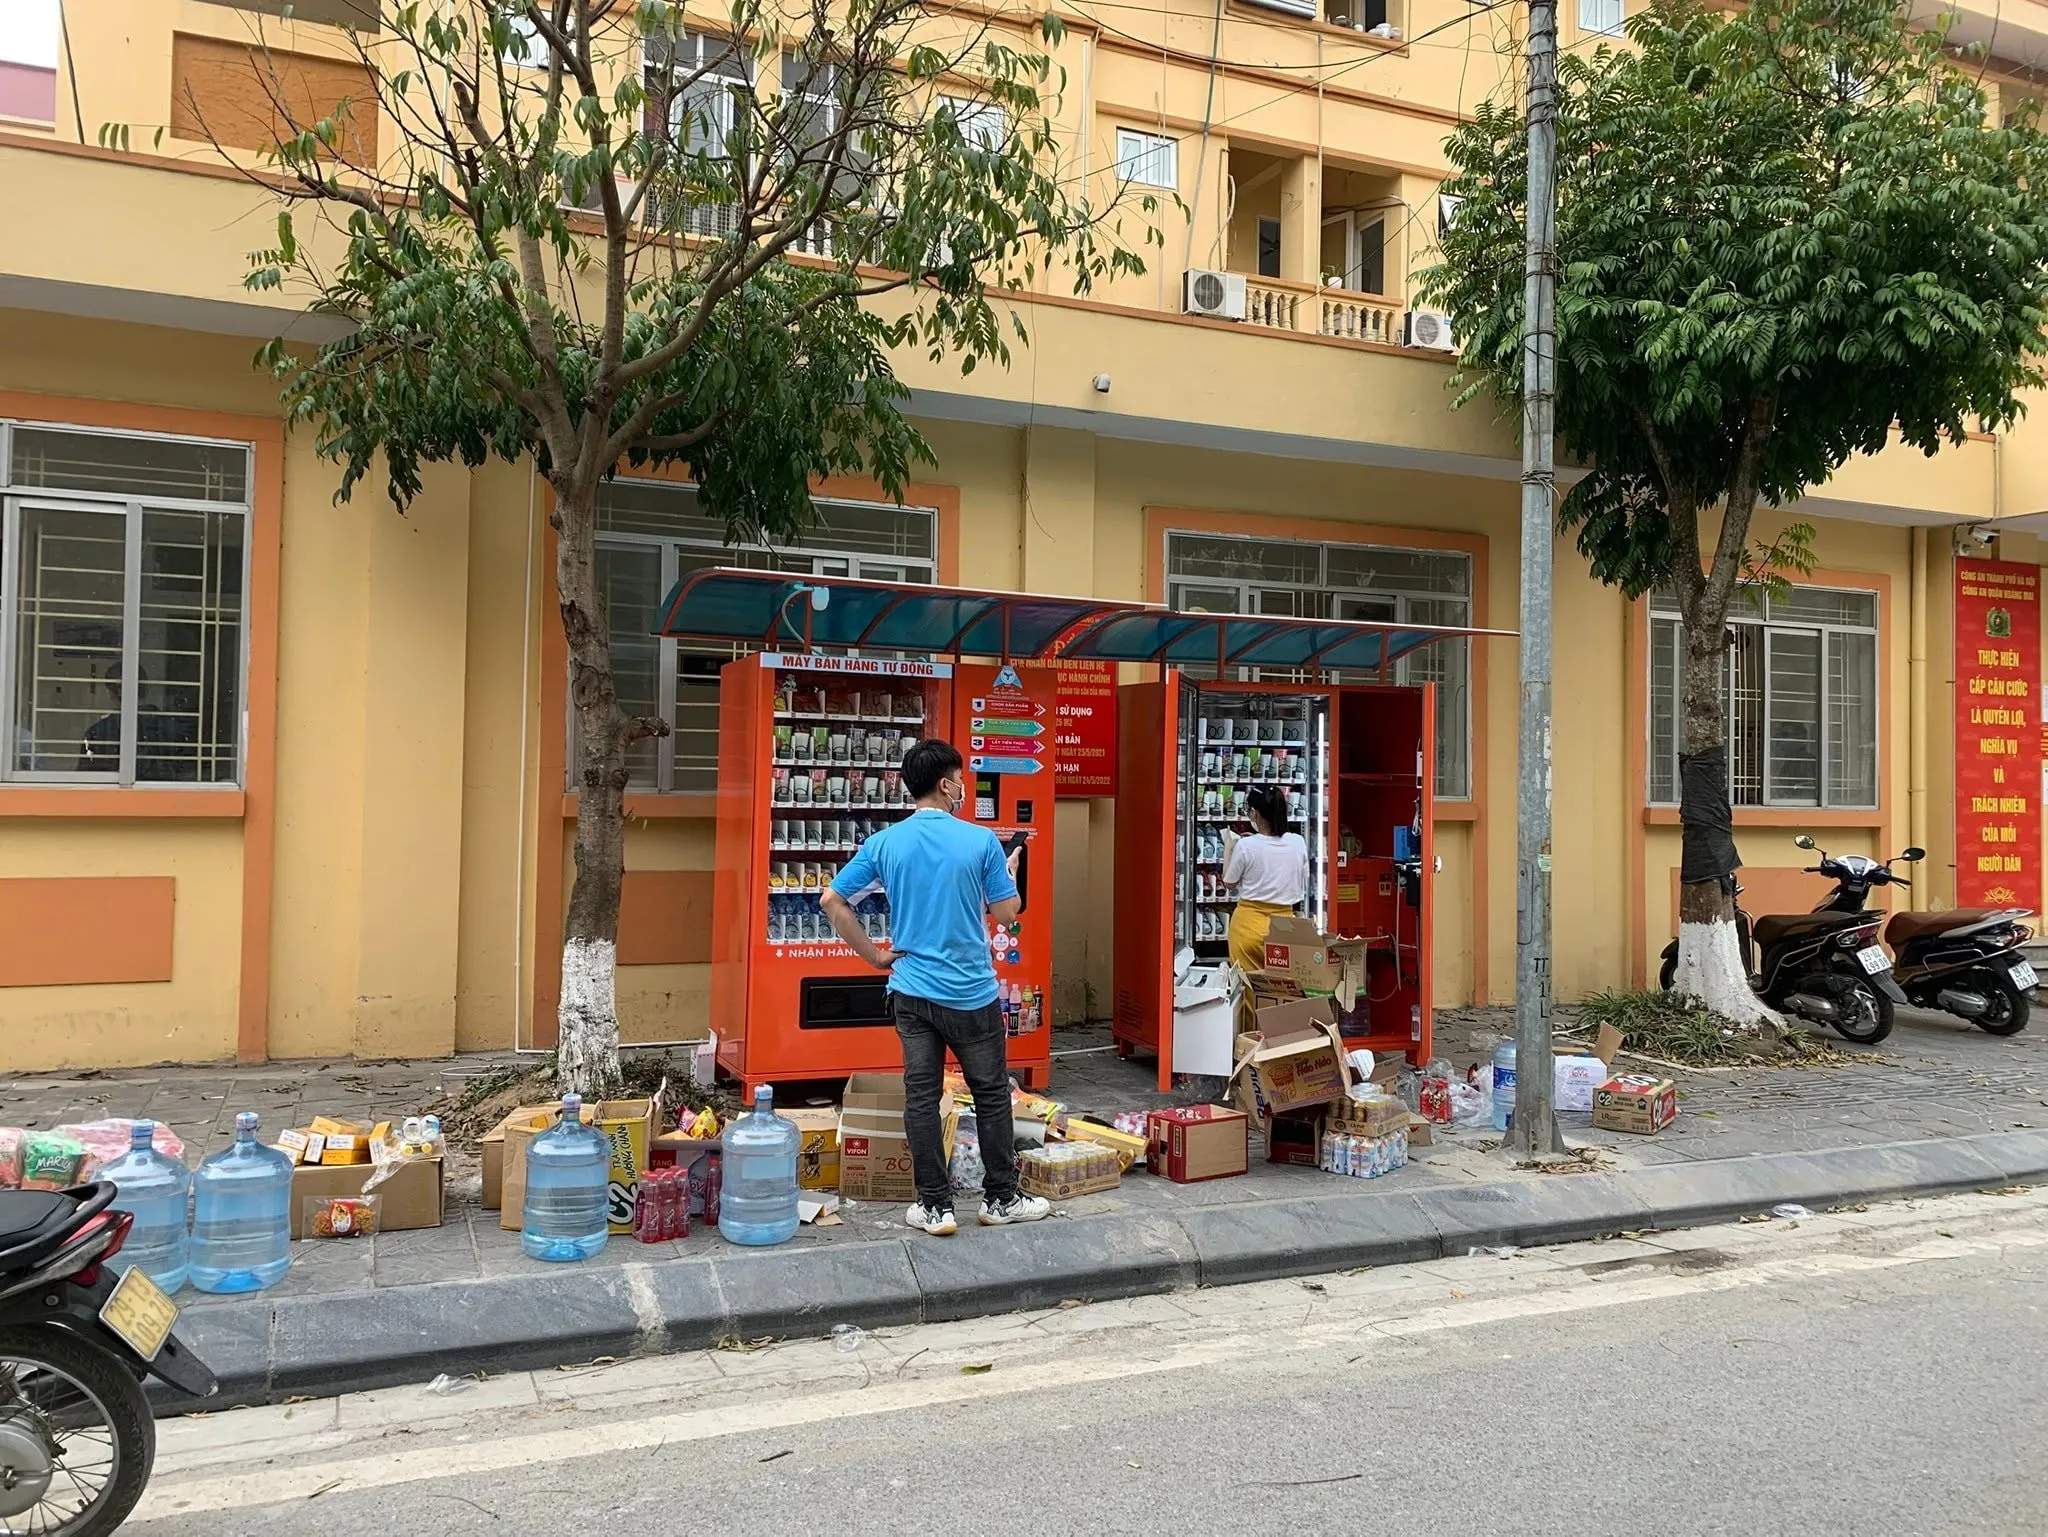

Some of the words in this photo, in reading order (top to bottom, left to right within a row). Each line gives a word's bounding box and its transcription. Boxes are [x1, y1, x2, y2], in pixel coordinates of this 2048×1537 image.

[782, 654, 811, 668] MÁY
[814, 656, 841, 670] BÁN
[845, 657, 878, 672] HÀNG
[882, 660, 898, 676] TỰ
[900, 660, 934, 677] ĐỘNG
[1978, 649, 1999, 669] THỰC
[2000, 649, 2020, 670] HIỆN
[1068, 670, 1088, 683] HÀNH
[1089, 672, 1111, 684] CHÍNH
[1969, 674, 1986, 695] CẤP
[1987, 677, 2005, 695] CĂN
[2006, 678, 2028, 697] CƯỚC
[1070, 706, 1093, 718] DỤNG
[1970, 705, 1982, 724] LÀ
[1065, 732, 1081, 744] BẢN
[1980, 735, 2006, 754] NGHĨA
[2006, 739, 2018, 758] VỤ
[1063, 763, 1080, 774] HẠN
[1993, 765, 2005, 784] VÀ
[1972, 794, 1999, 813] TRÁCH
[2000, 795, 2027, 816] NHIỆM
[1982, 822, 1999, 842] CỦA
[2000, 822, 2017, 842] MỖI
[1977, 853, 2003, 872] NGƯỜI
[2004, 853, 2021, 872] DÂN
[789, 946, 824, 959] NHẬN
[1268, 957, 1288, 966] VIFON
[1598, 1091, 1612, 1106] C2
